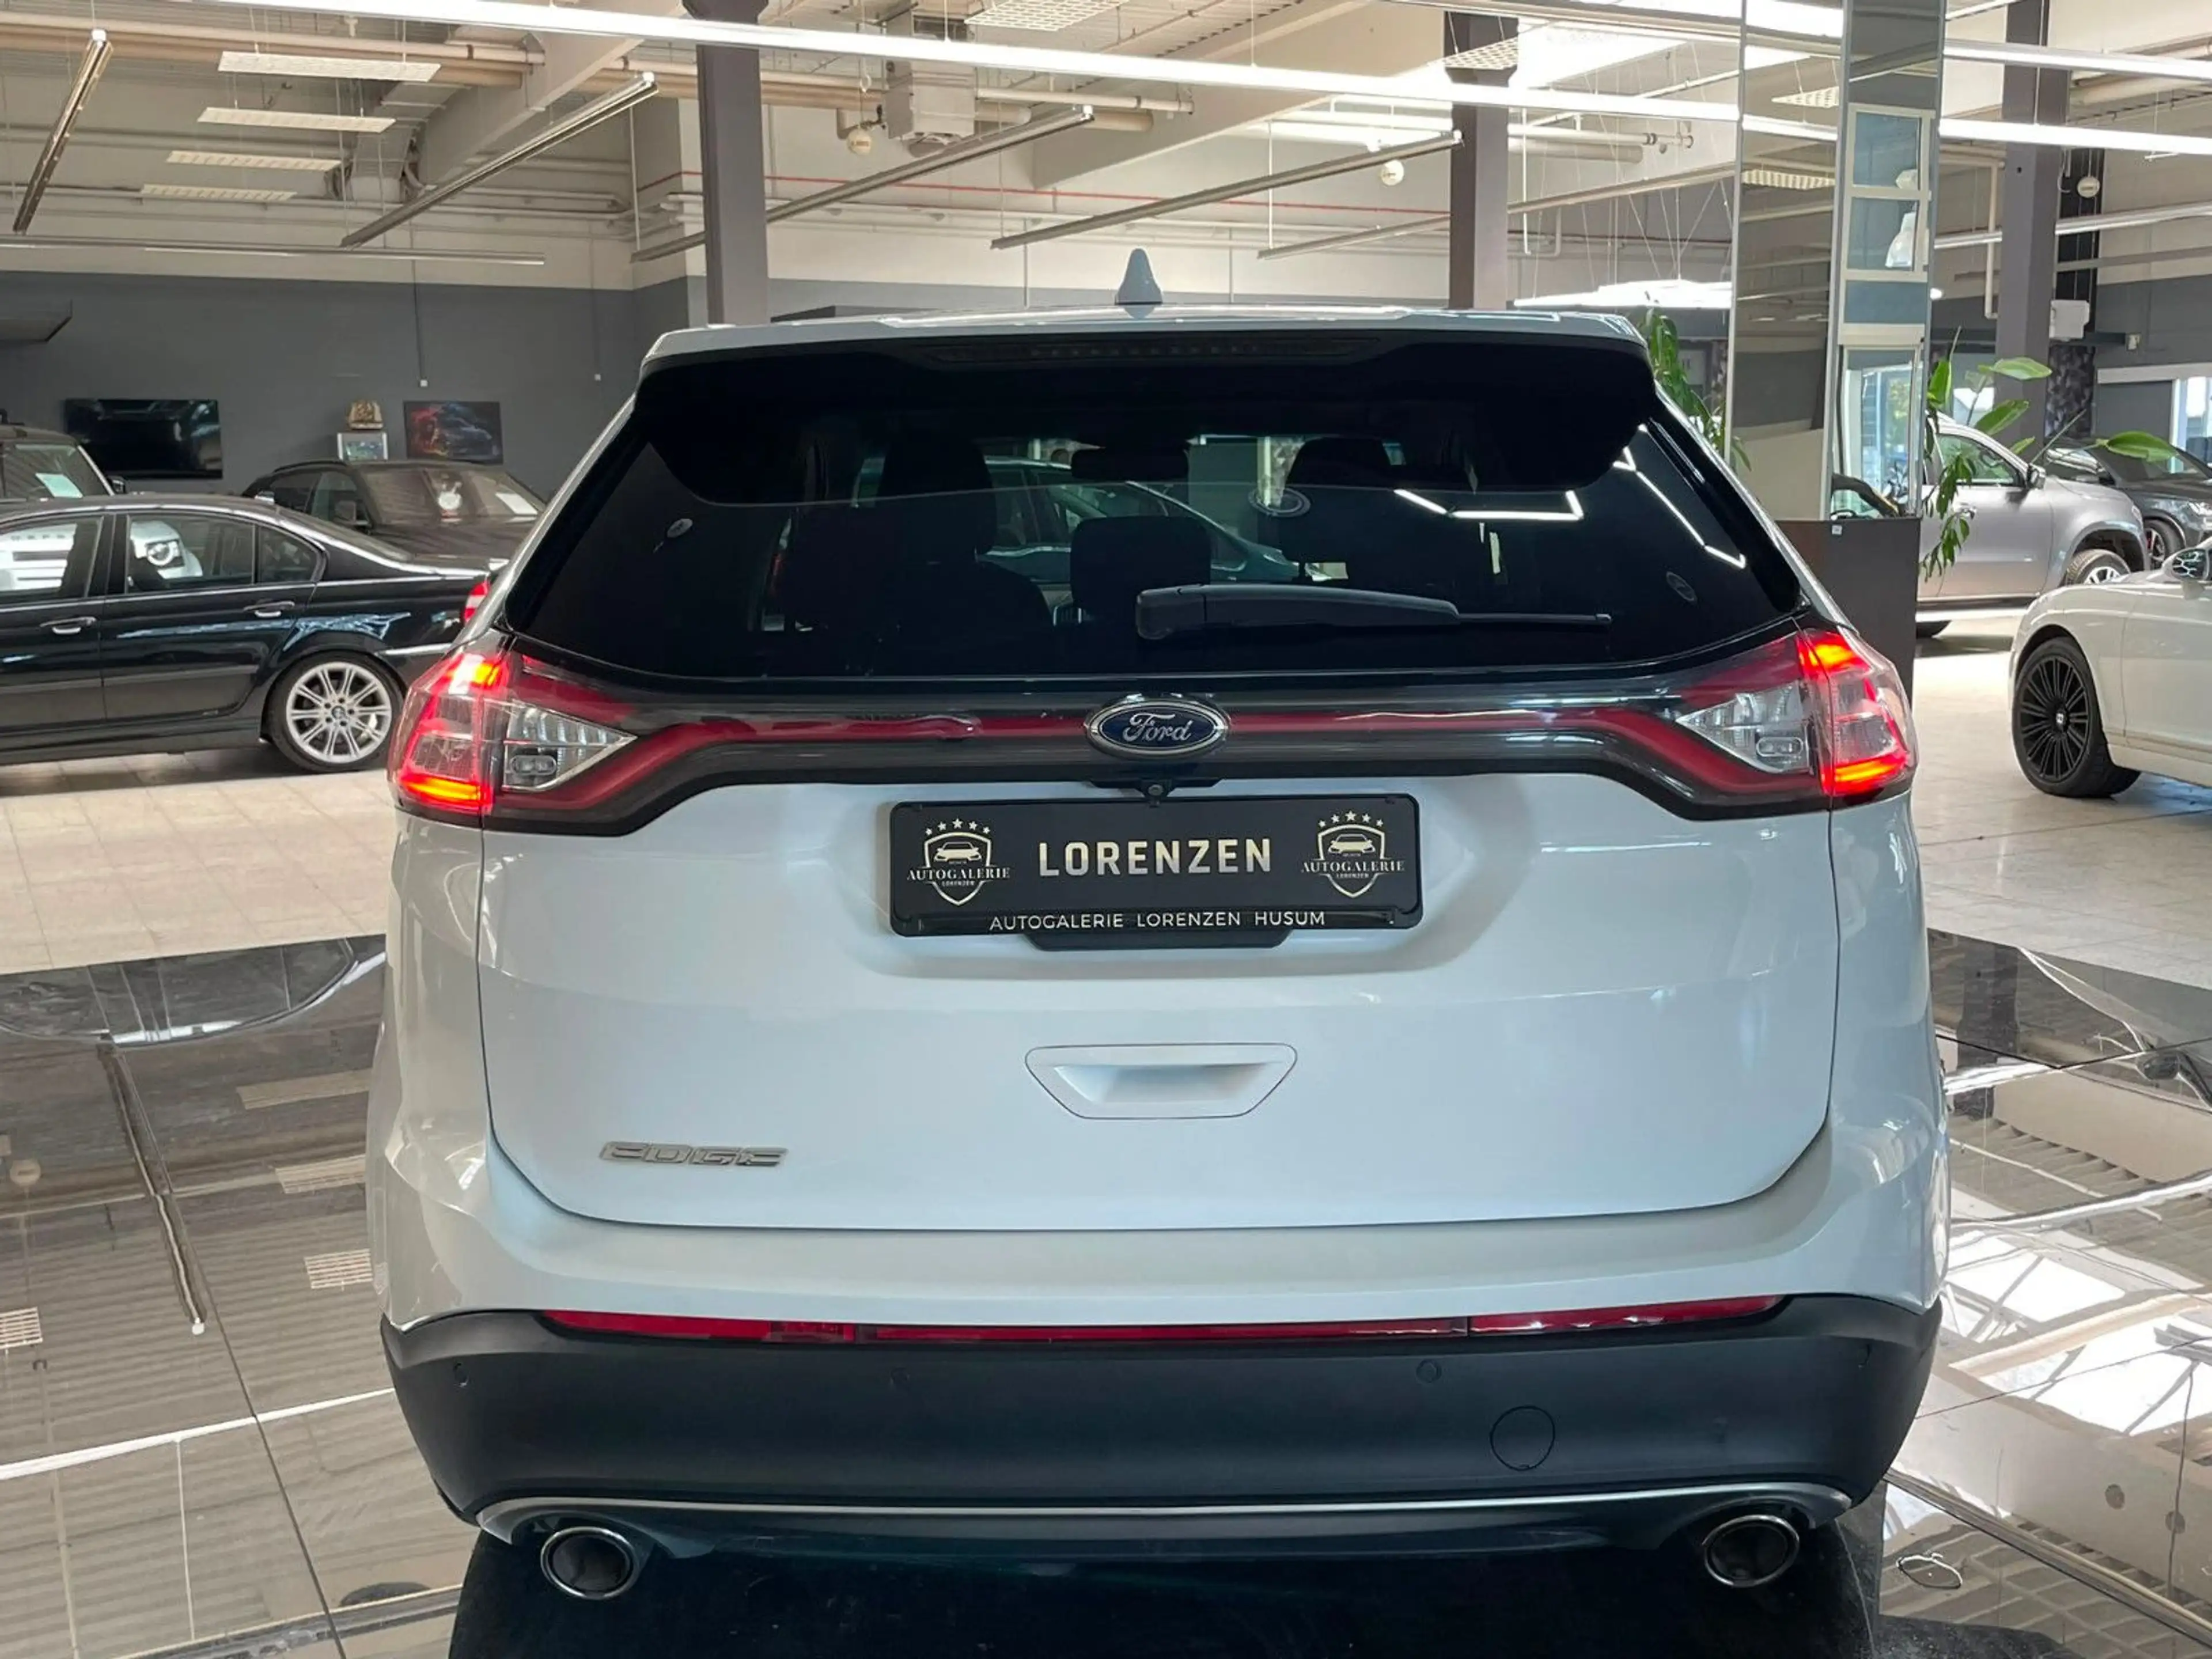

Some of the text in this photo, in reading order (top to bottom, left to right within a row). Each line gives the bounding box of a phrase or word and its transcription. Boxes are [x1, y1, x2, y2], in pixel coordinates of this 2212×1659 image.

[1123, 713, 1193, 742] Ford
[1039, 838, 1271, 876] LORENZEN
[1300, 860, 1405, 873] AUTOGALERIE
[907, 867, 1010, 881] AUTOGALERIE
[989, 911, 1325, 930] AUTOGALERIE LORENZEN HUSUM
[599, 1141, 790, 1166] EDGE
